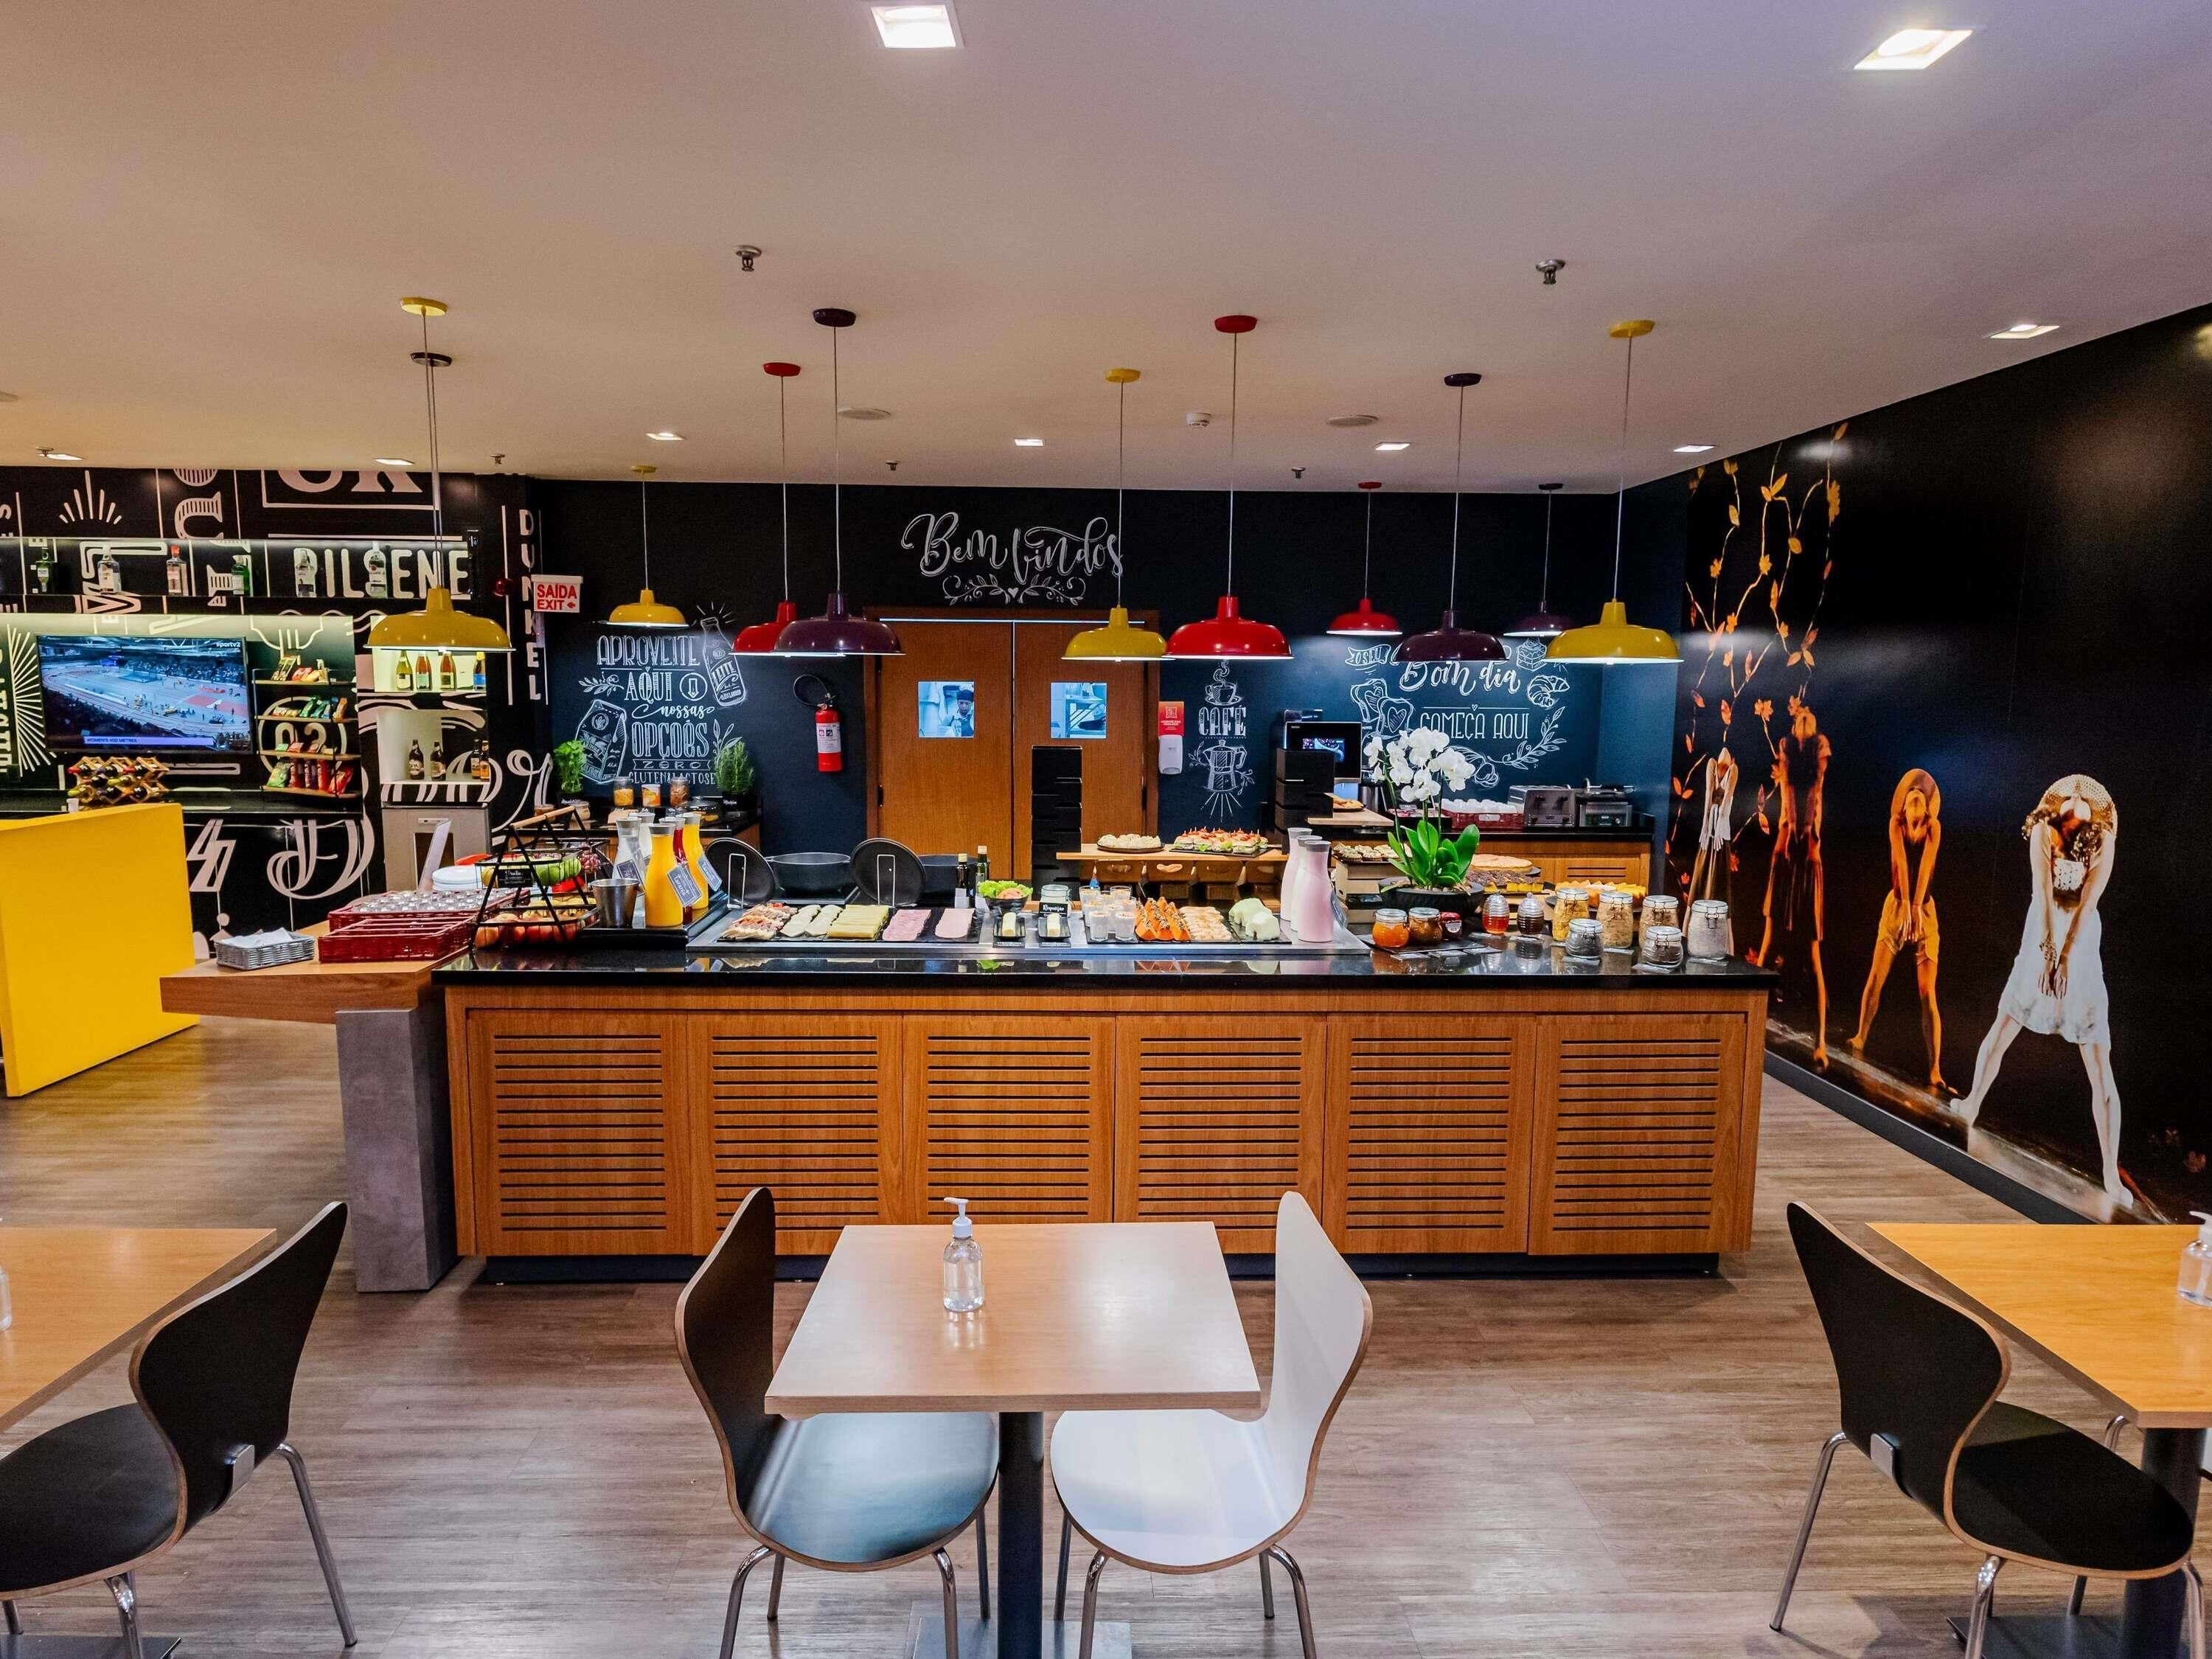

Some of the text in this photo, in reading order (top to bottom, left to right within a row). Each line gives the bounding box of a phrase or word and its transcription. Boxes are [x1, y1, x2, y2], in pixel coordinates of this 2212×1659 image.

[901, 512, 1007, 577] Bem
[537, 583, 577, 599] SAÍDA
[537, 599, 565, 611] EXIT
[597, 635, 700, 667] APROVEITE
[624, 672, 672, 704] AQUI
[1399, 661, 1521, 696] Bom dia
[639, 703, 714, 719] nossas
[1198, 705, 1246, 737] CAFÉ
[1420, 712, 1529, 740] COMEÇA AQUI
[642, 761, 701, 769] ZERO
